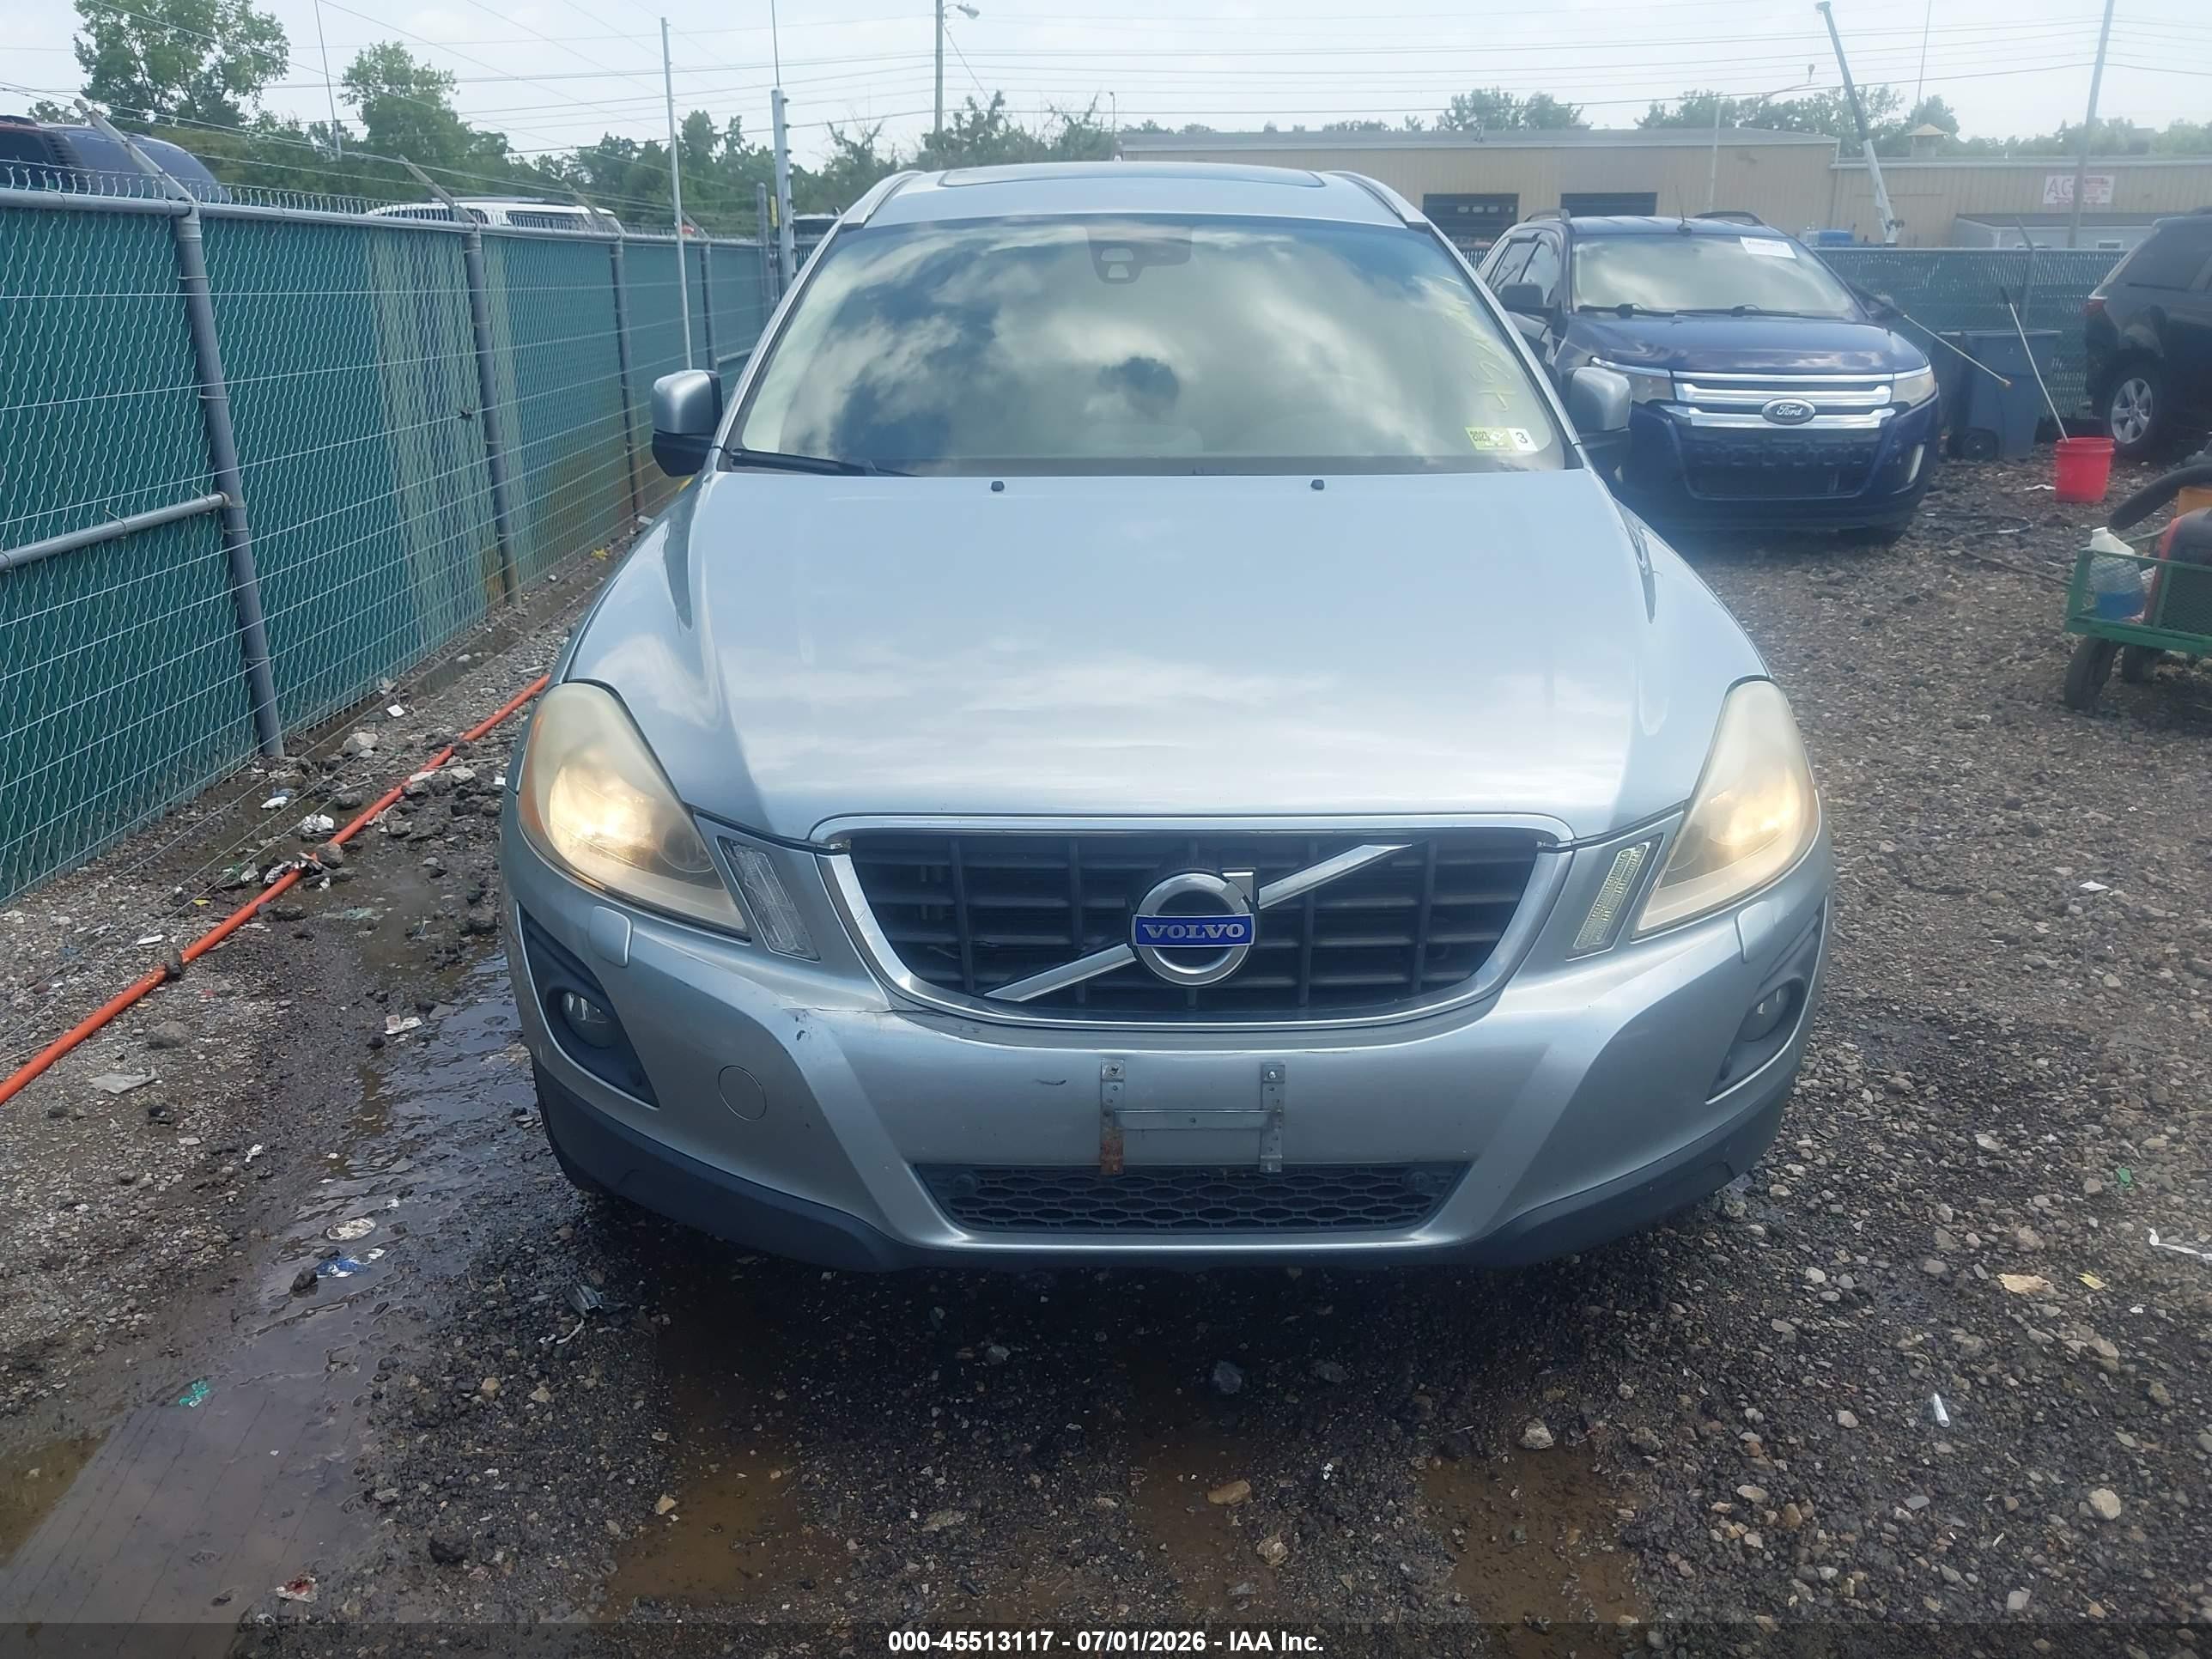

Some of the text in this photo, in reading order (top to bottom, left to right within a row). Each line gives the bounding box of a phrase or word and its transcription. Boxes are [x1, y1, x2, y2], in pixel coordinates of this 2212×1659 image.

[1776, 404, 1803, 416] Ford
[1516, 432, 1528, 444] 3
[1141, 923, 1245, 939] VOLVO
